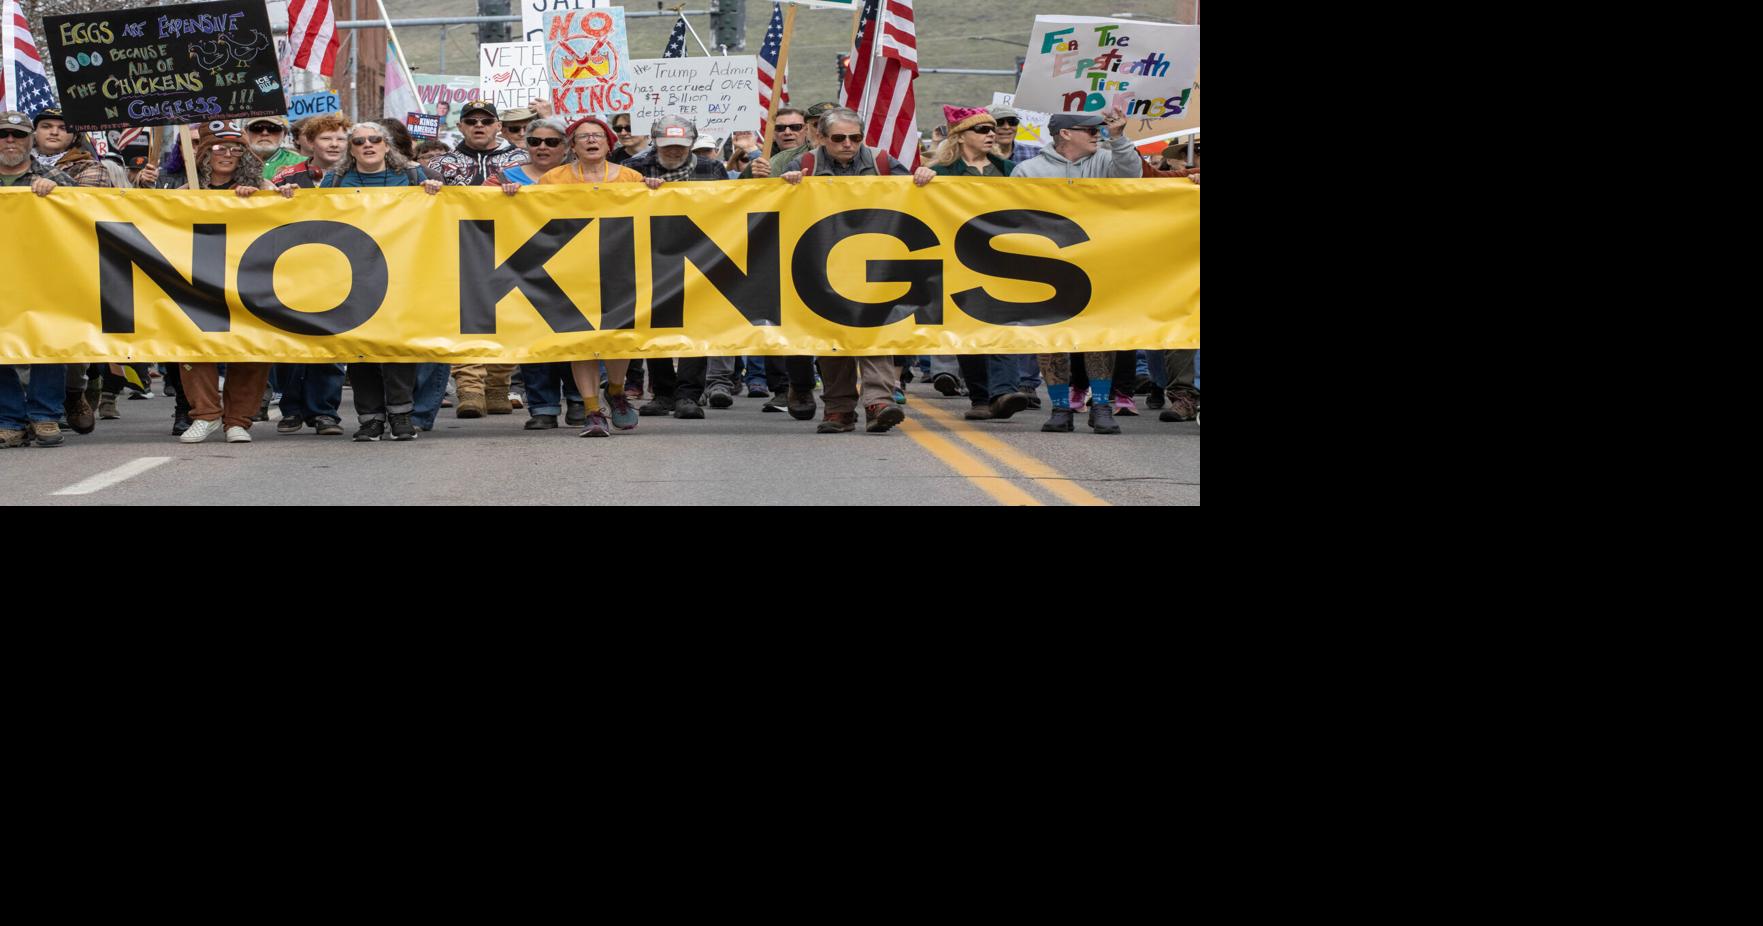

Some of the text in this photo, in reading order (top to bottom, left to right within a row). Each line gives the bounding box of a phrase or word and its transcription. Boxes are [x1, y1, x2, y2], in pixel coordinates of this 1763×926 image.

[60, 11, 245, 46] EGGS ARE EXPENSIVE
[549, 12, 613, 40] NO
[1094, 25, 1130, 47] The
[109, 44, 167, 61] BECAUSE
[128, 57, 174, 78] ALL OF
[653, 62, 698, 83] Trump
[709, 61, 754, 76] Admin
[66, 72, 247, 99] THE CHICKENS ARE
[634, 80, 753, 93] has accrued OVER
[128, 96, 222, 120] CONGRESS
[552, 82, 634, 115] KINGS
[645, 93, 660, 105] $7
[637, 106, 665, 118] debt
[708, 103, 730, 114] DAY
[420, 117, 438, 127] KINGS
[95, 208, 1092, 335] NO KINGS
